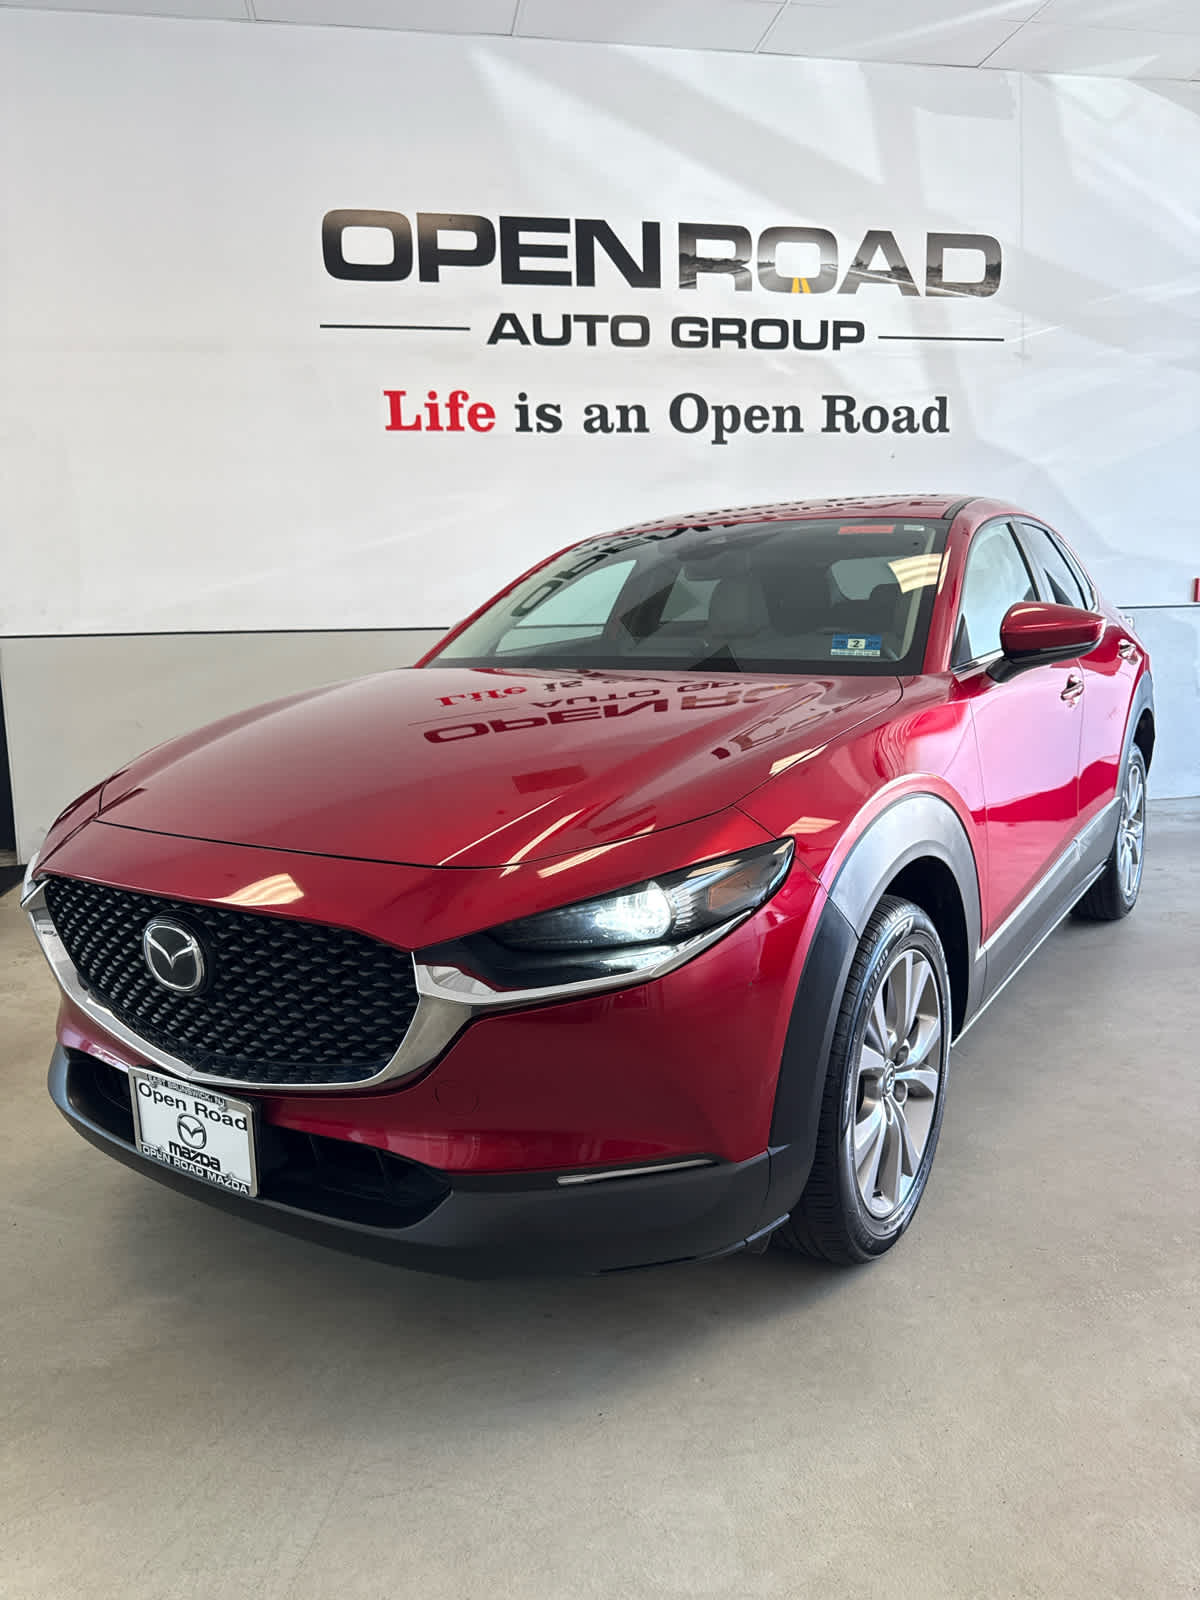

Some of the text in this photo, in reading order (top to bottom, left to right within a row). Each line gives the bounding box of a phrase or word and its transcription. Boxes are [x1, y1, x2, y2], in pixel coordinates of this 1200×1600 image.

[322, 209, 1003, 298] OPEN ROAD
[487, 313, 865, 350] AUTO GROUP
[384, 390, 949, 444] Life is an Open Road
[138, 1082, 248, 1132] Open Road
[142, 1145, 249, 1195] OPEN ROAD MAZDA
[168, 1141, 221, 1173] mazda
